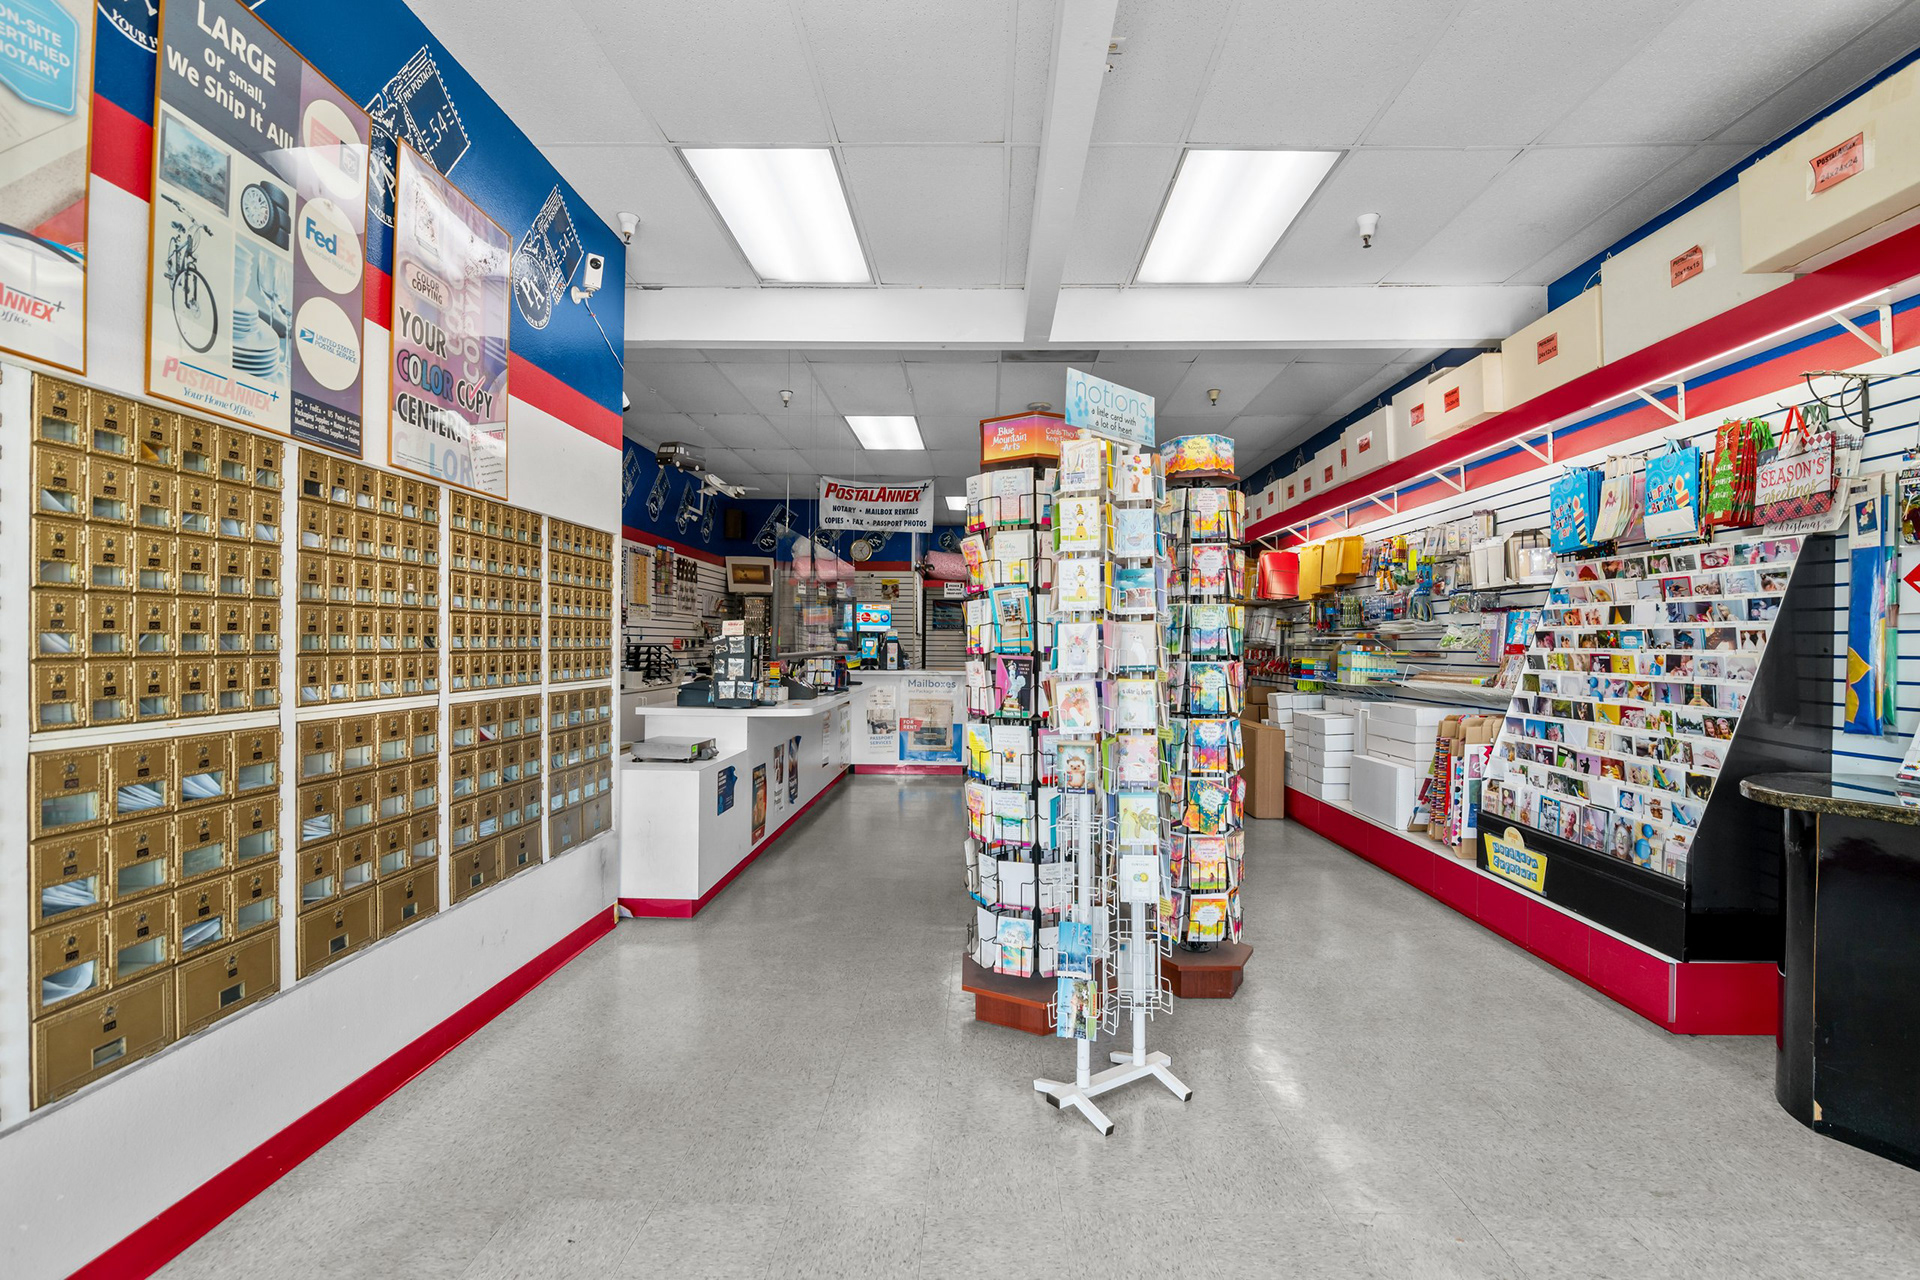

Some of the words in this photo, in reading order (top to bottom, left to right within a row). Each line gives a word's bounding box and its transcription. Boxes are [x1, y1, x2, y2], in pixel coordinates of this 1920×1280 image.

[112, 8, 147, 45] YOUR
[197, 0, 277, 87] LARGE
[0, 42, 60, 79] OTARY
[166, 44, 199, 88] We
[204, 74, 246, 120] Ship
[250, 107, 264, 133] It
[204, 47, 226, 73] or
[228, 69, 267, 110] small,
[306, 216, 358, 268] FedEx
[411, 278, 443, 305] COPYING
[416, 271, 440, 291] COLOR
[398, 306, 447, 360] YOUR
[397, 349, 453, 402] COLOR
[183, 387, 204, 401] Your
[205, 394, 229, 409] Home
[229, 402, 254, 417] Office
[456, 379, 493, 420] COPY
[1075, 381, 1147, 418] notions
[998, 427, 1014, 436] Blue
[1097, 406, 1109, 419] little
[1110, 413, 1124, 423] card
[1125, 417, 1137, 426] with
[1101, 418, 1109, 428] lot
[1110, 421, 1117, 430] of
[1118, 423, 1133, 435] heart
[991, 432, 1027, 446] Mountain
[1001, 443, 1020, 451] Arts
[1761, 456, 1826, 489] SEASON'S
[1647, 482, 1674, 503] Happy
[1760, 480, 1822, 514] greetings
[832, 505, 856, 513] NOTARY
[1551, 502, 1572, 521] Happy
[908, 680, 956, 688] Mailboxes
